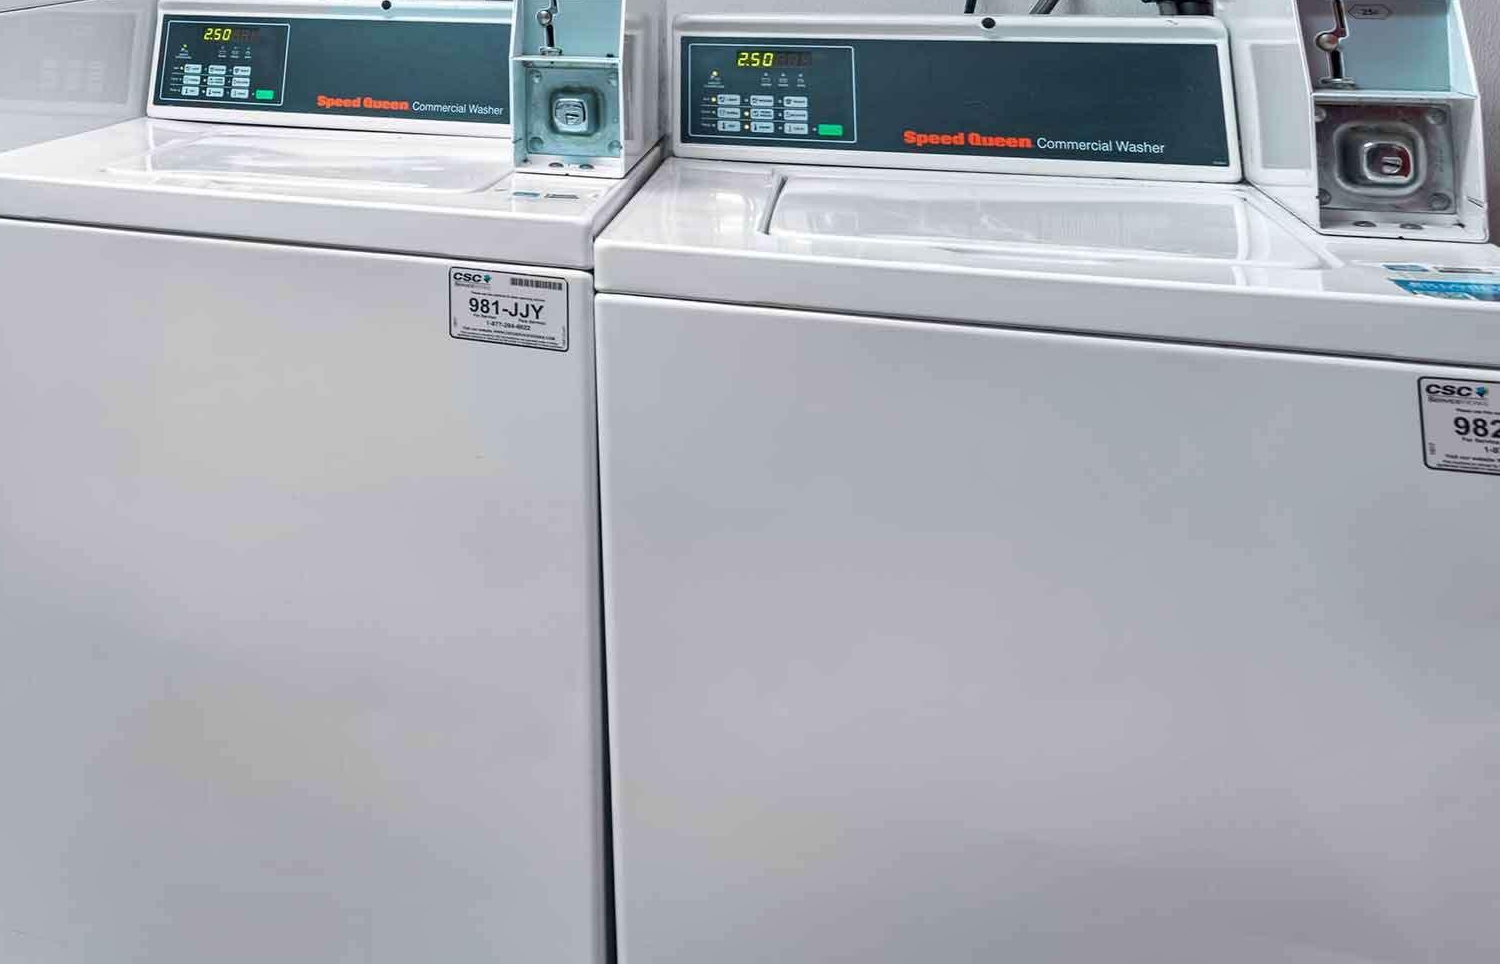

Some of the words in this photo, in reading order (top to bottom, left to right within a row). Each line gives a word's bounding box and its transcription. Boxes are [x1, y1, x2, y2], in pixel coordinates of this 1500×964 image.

[203, 28, 232, 41] 2.50
[737, 52, 774, 66] 2.50
[317, 95, 362, 109] Speed
[363, 97, 410, 111] Queen
[412, 101, 467, 113] Commercial
[469, 104, 504, 115] Washer
[903, 130, 965, 147] Speed
[967, 132, 1032, 149] Queen
[1036, 137, 1112, 152] Commercial
[1116, 141, 1165, 154] Washer
[453, 272, 482, 283] CSC
[469, 297, 544, 320] 981-JJY
[1426, 384, 1472, 396] CSC
[1454, 416, 1500, 438] 982
